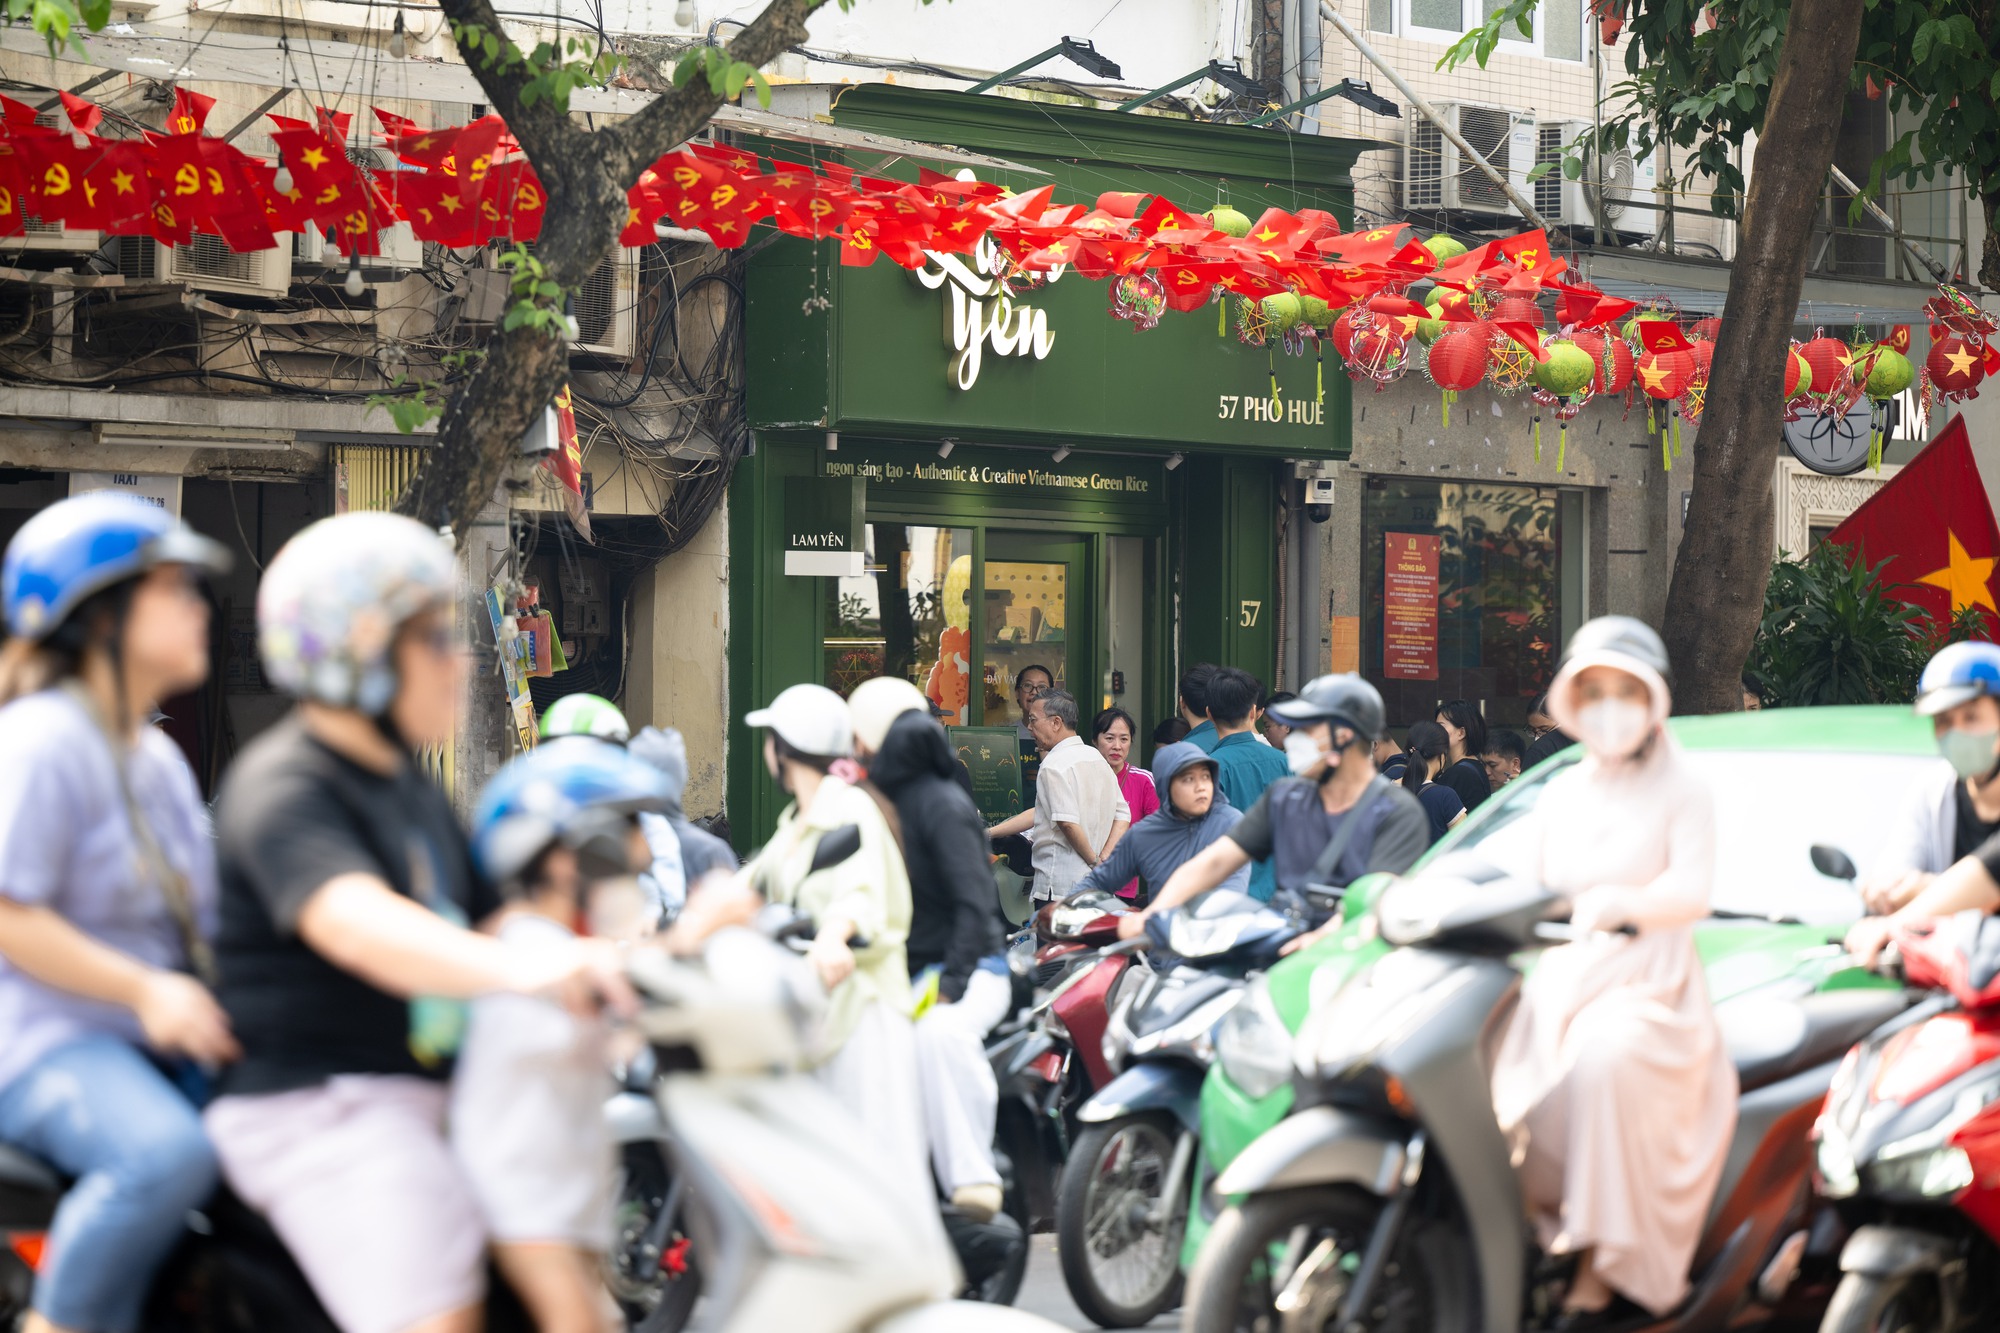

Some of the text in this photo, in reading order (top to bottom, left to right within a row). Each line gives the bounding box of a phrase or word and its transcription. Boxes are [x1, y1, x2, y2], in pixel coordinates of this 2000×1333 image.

[1218, 395, 1239, 419] 57
[856, 459, 883, 483] sáng
[885, 462, 904, 483] tạo
[913, 462, 967, 482] Authentic
[969, 466, 979, 483] &
[981, 466, 1027, 485] Creative
[1028, 469, 1088, 489] Vietnamese
[1091, 473, 1124, 491] Green
[1125, 475, 1149, 492] Rice
[792, 531, 844, 547] LAM YÊN
[1240, 600, 1261, 627] 57
